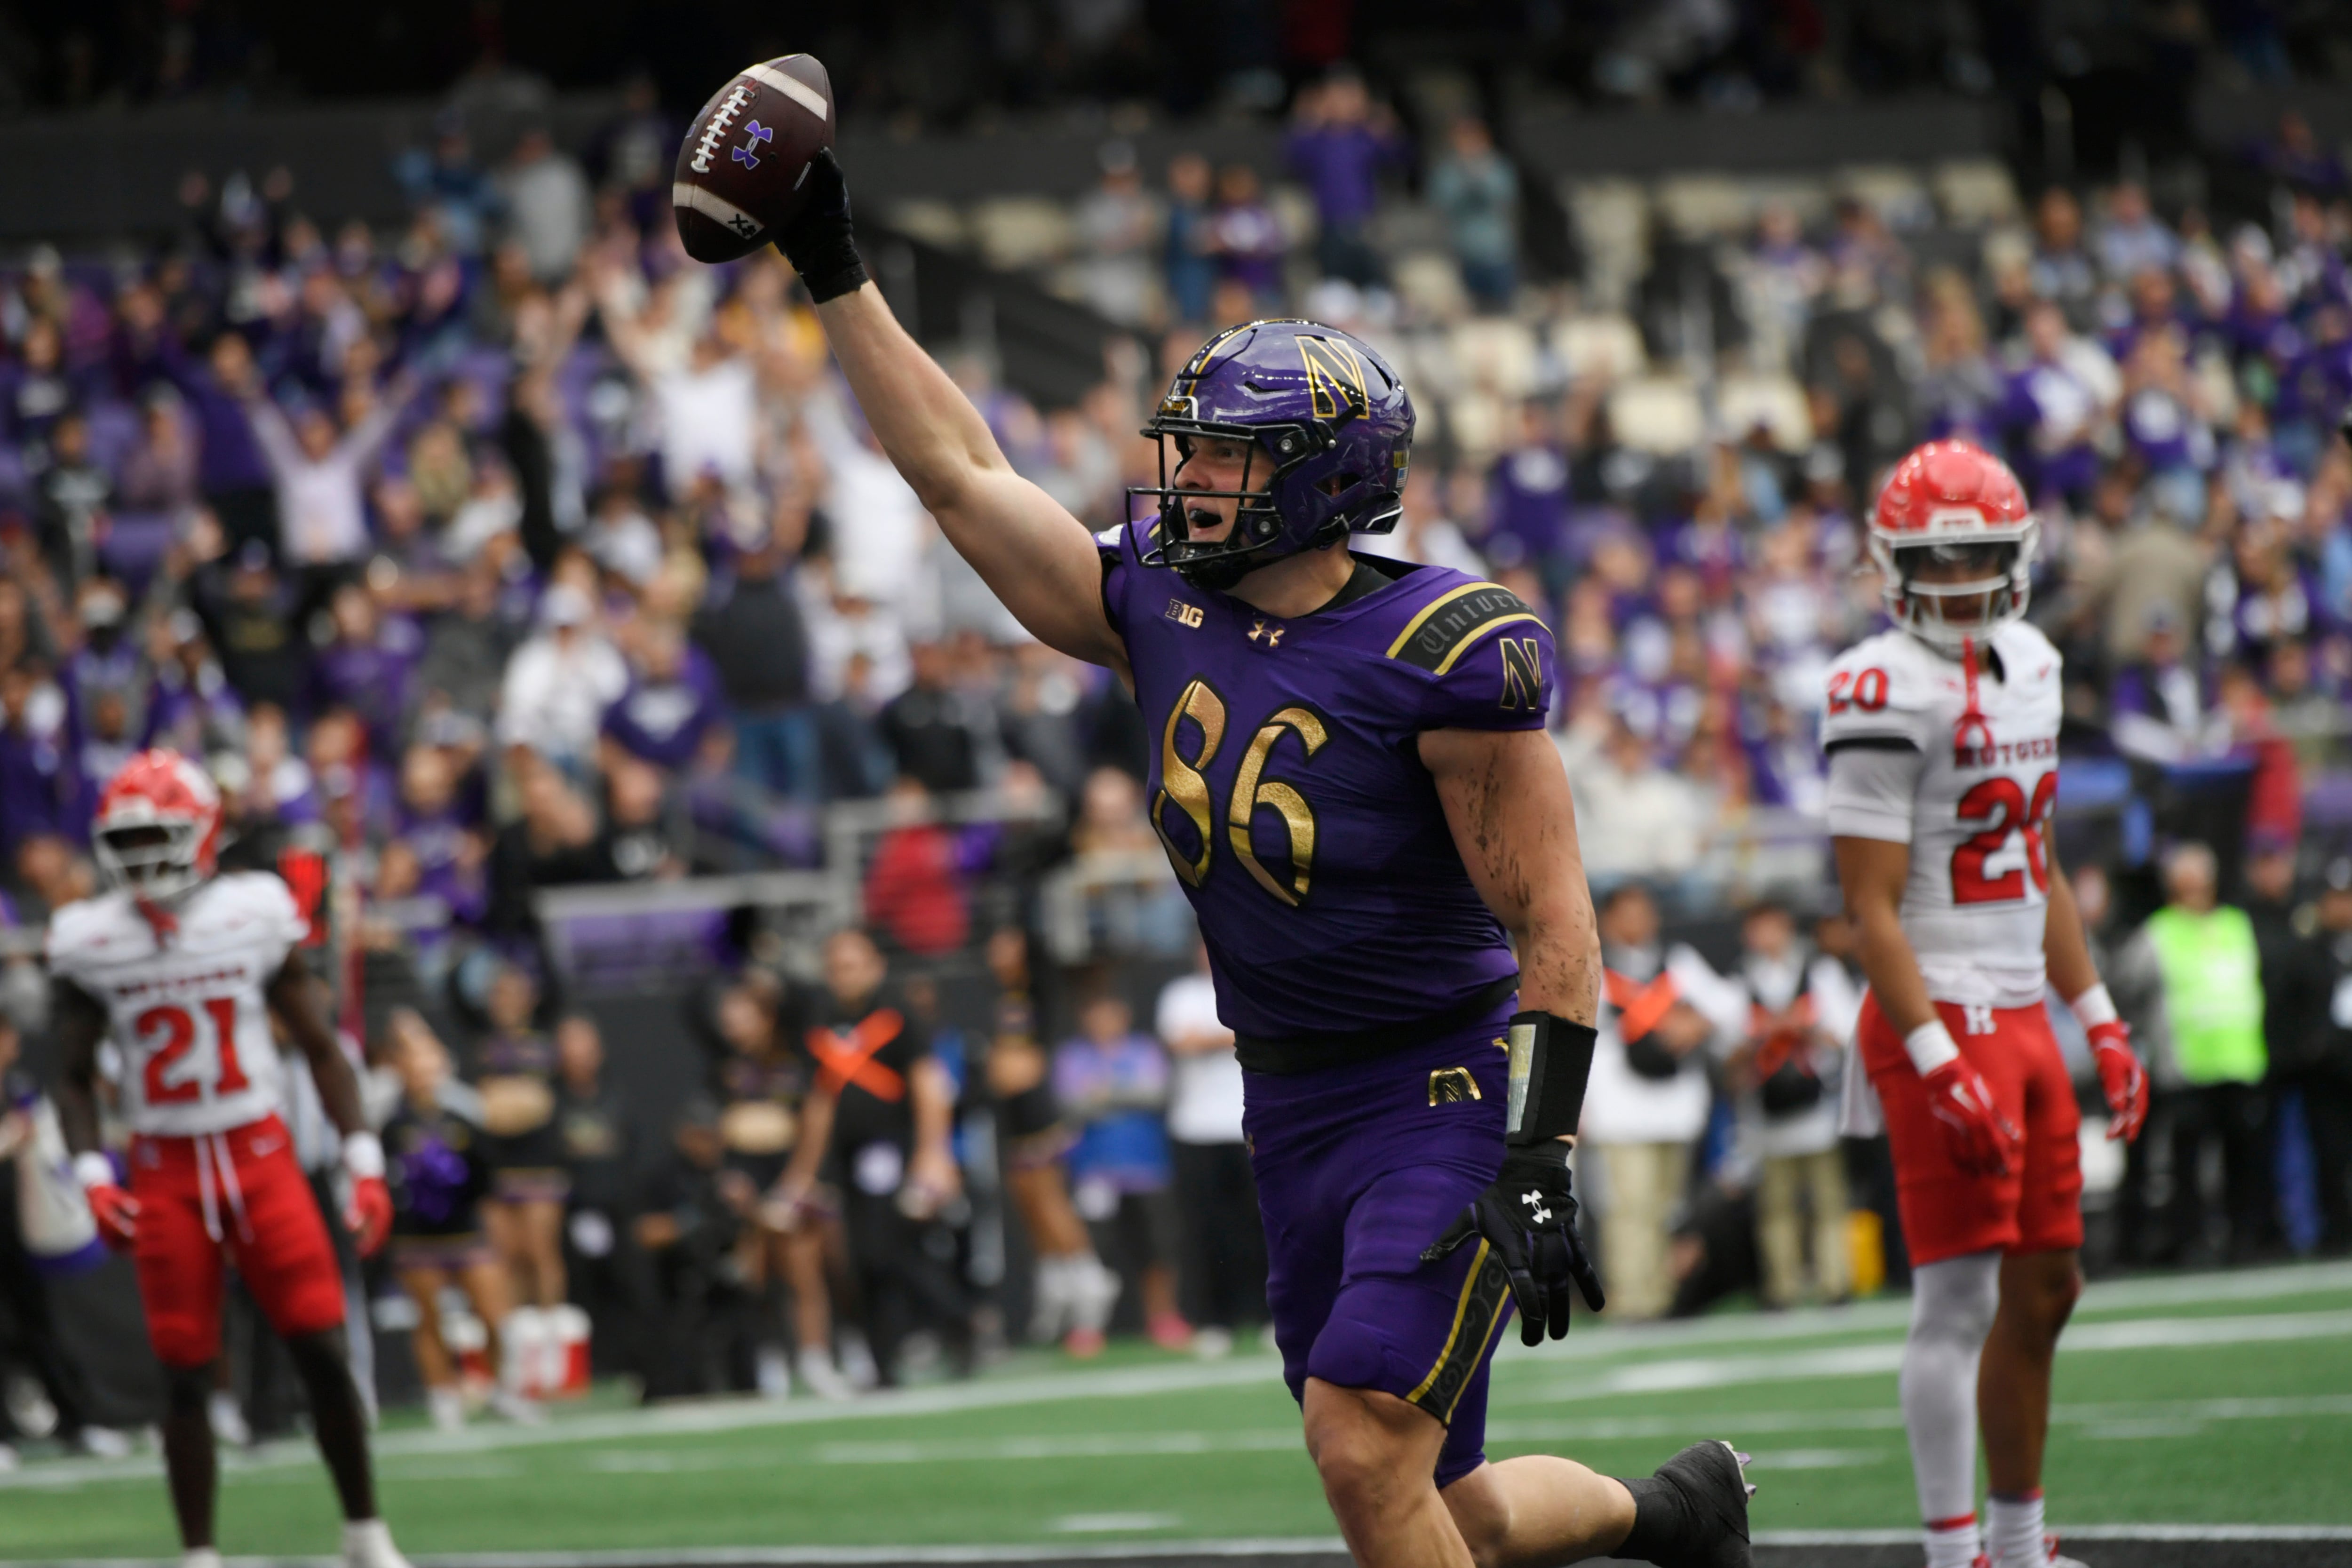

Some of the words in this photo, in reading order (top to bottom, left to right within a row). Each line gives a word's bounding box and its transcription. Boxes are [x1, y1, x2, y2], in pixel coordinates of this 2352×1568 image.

[1294, 334, 1370, 420] N
[1165, 598, 1204, 629] BIG
[1499, 637, 1543, 711] N
[1828, 667, 1889, 717] 20
[1151, 675, 1331, 910] 86
[135, 996, 250, 1106] 21
